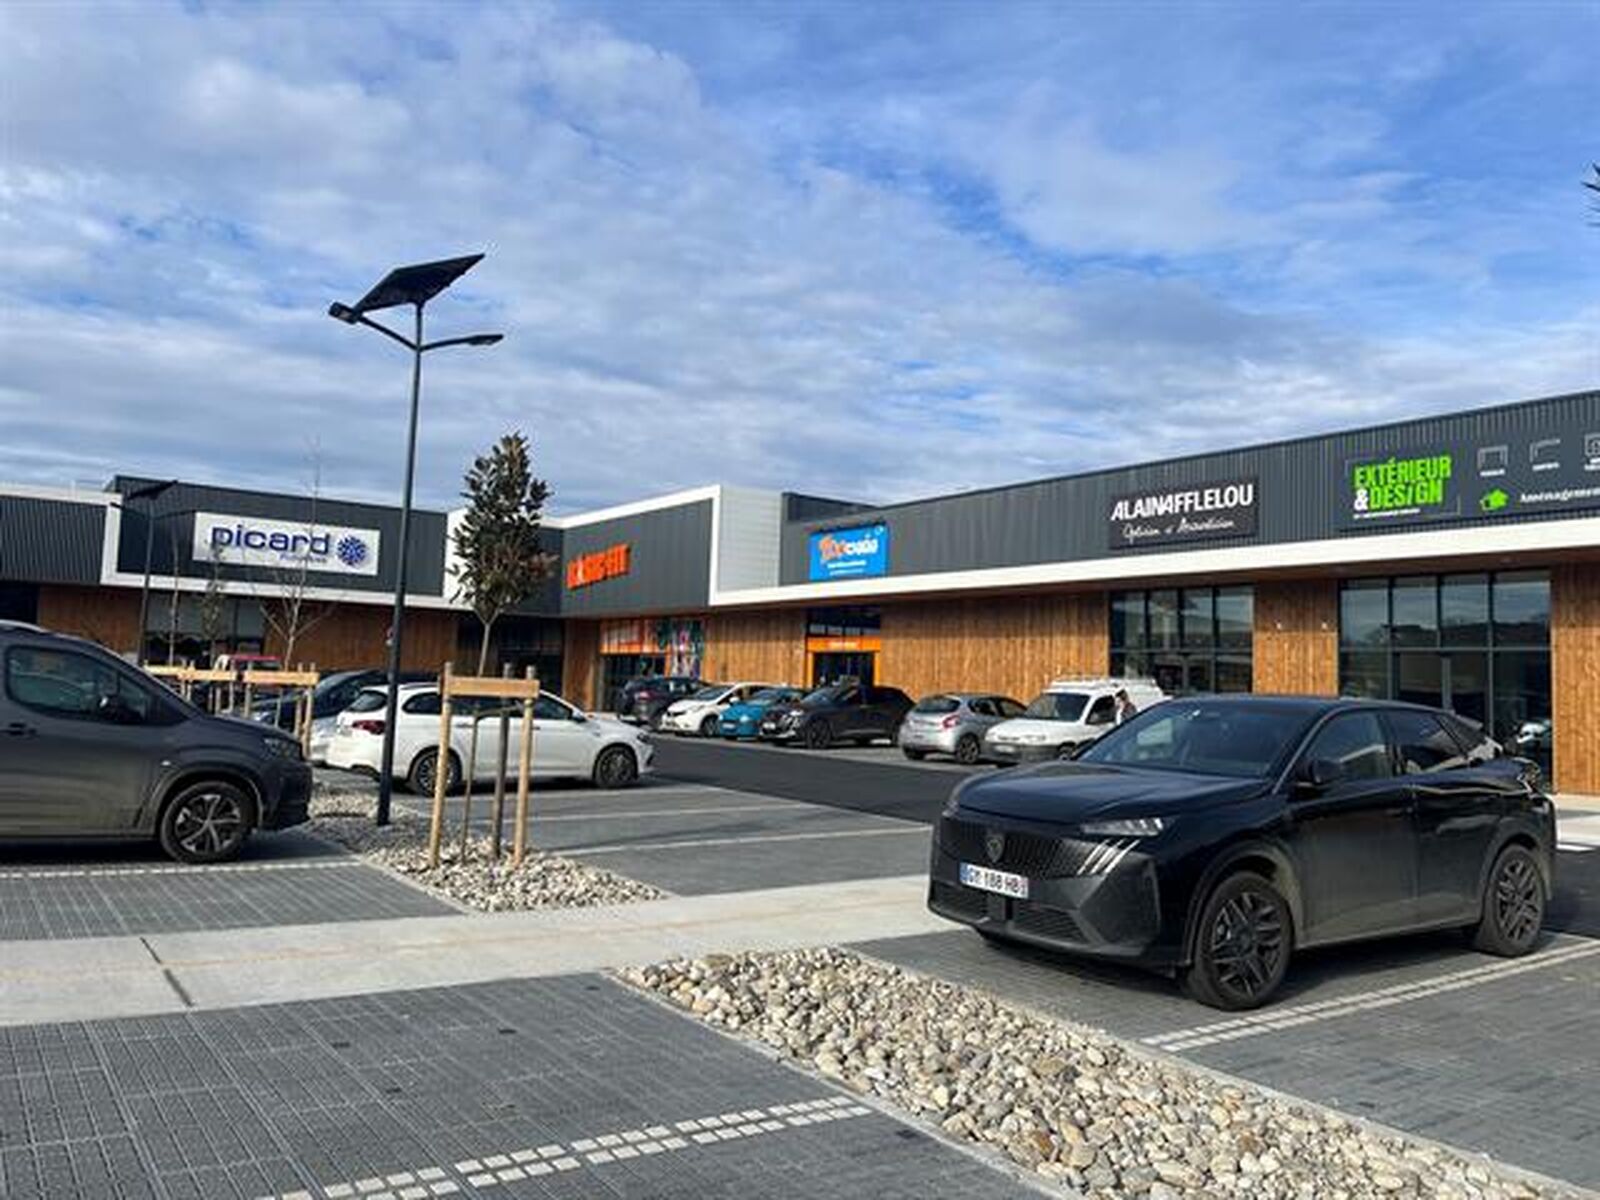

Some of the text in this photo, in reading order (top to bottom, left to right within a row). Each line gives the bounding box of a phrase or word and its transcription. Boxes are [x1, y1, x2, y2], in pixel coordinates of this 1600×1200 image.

[1354, 456, 1451, 489] EXTÉRIEUR
[1354, 479, 1442, 511] & DESIGN
[211, 523, 331, 557] picard
